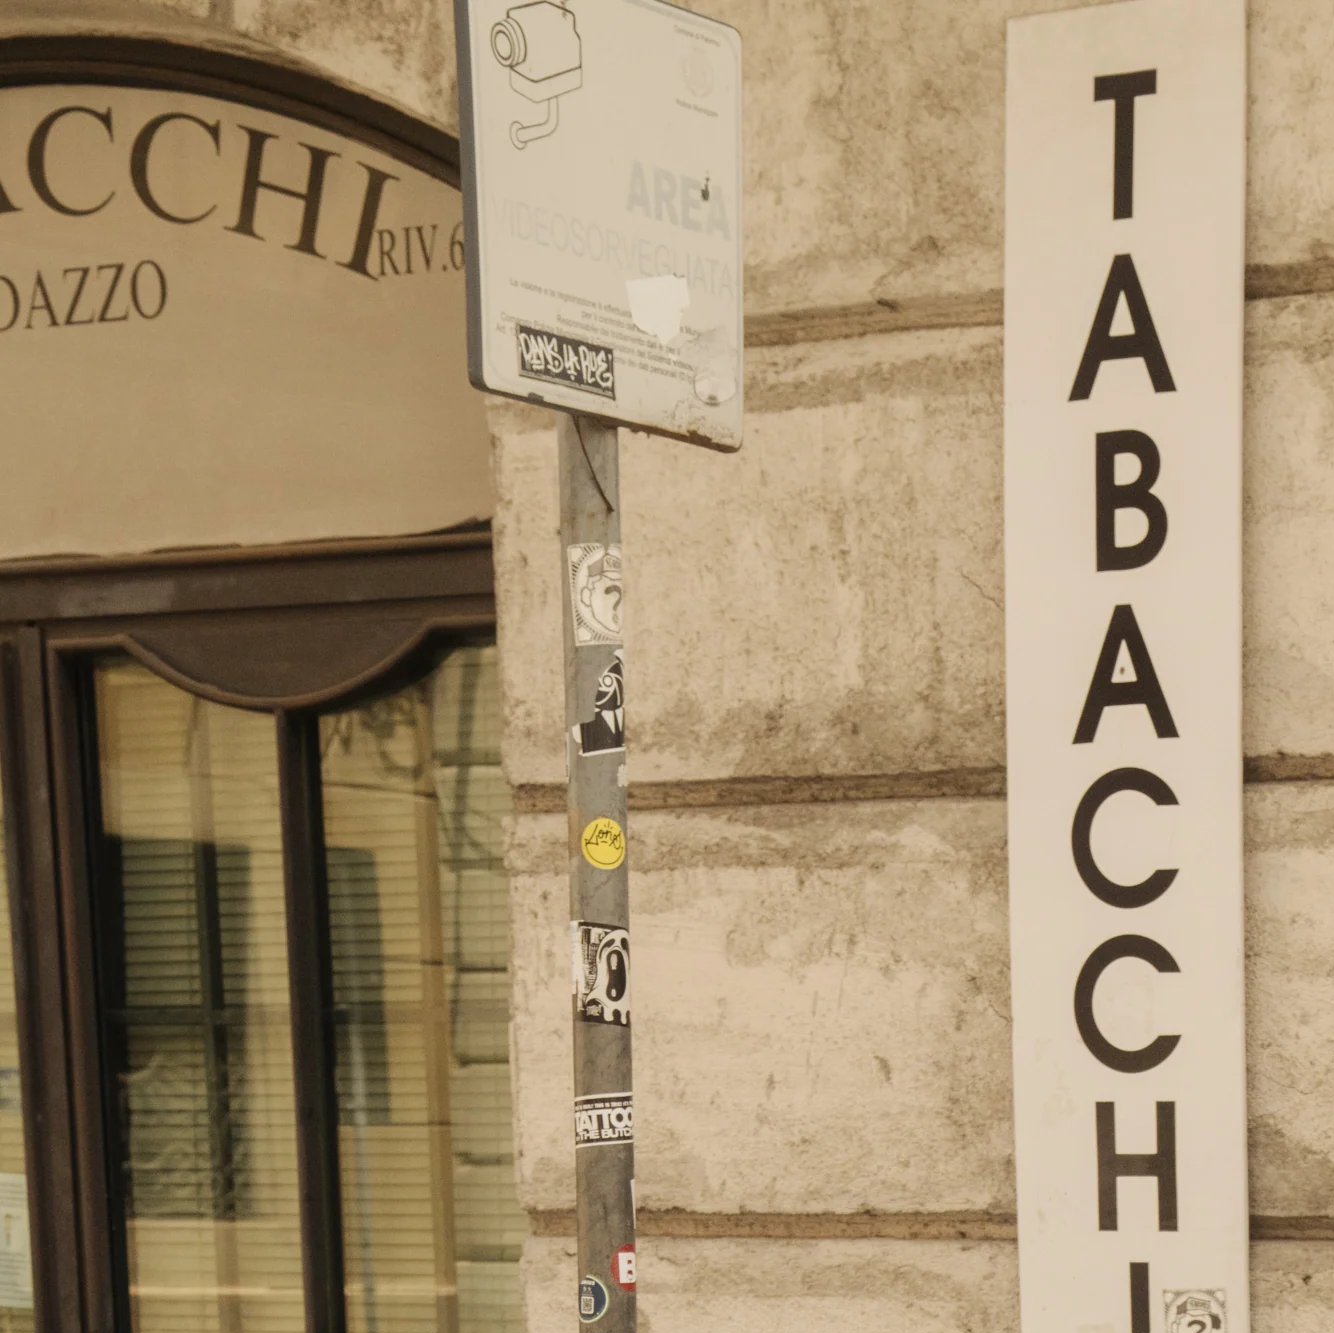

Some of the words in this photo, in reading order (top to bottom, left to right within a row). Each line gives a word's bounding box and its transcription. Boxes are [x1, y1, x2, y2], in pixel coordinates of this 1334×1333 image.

[0, 105, 401, 282] CCHI
[625, 160, 732, 242] AREA
[574, 1106, 633, 1133] TATTOO
[579, 1130, 600, 1141] THE
[601, 1127, 633, 1139] BUTC
